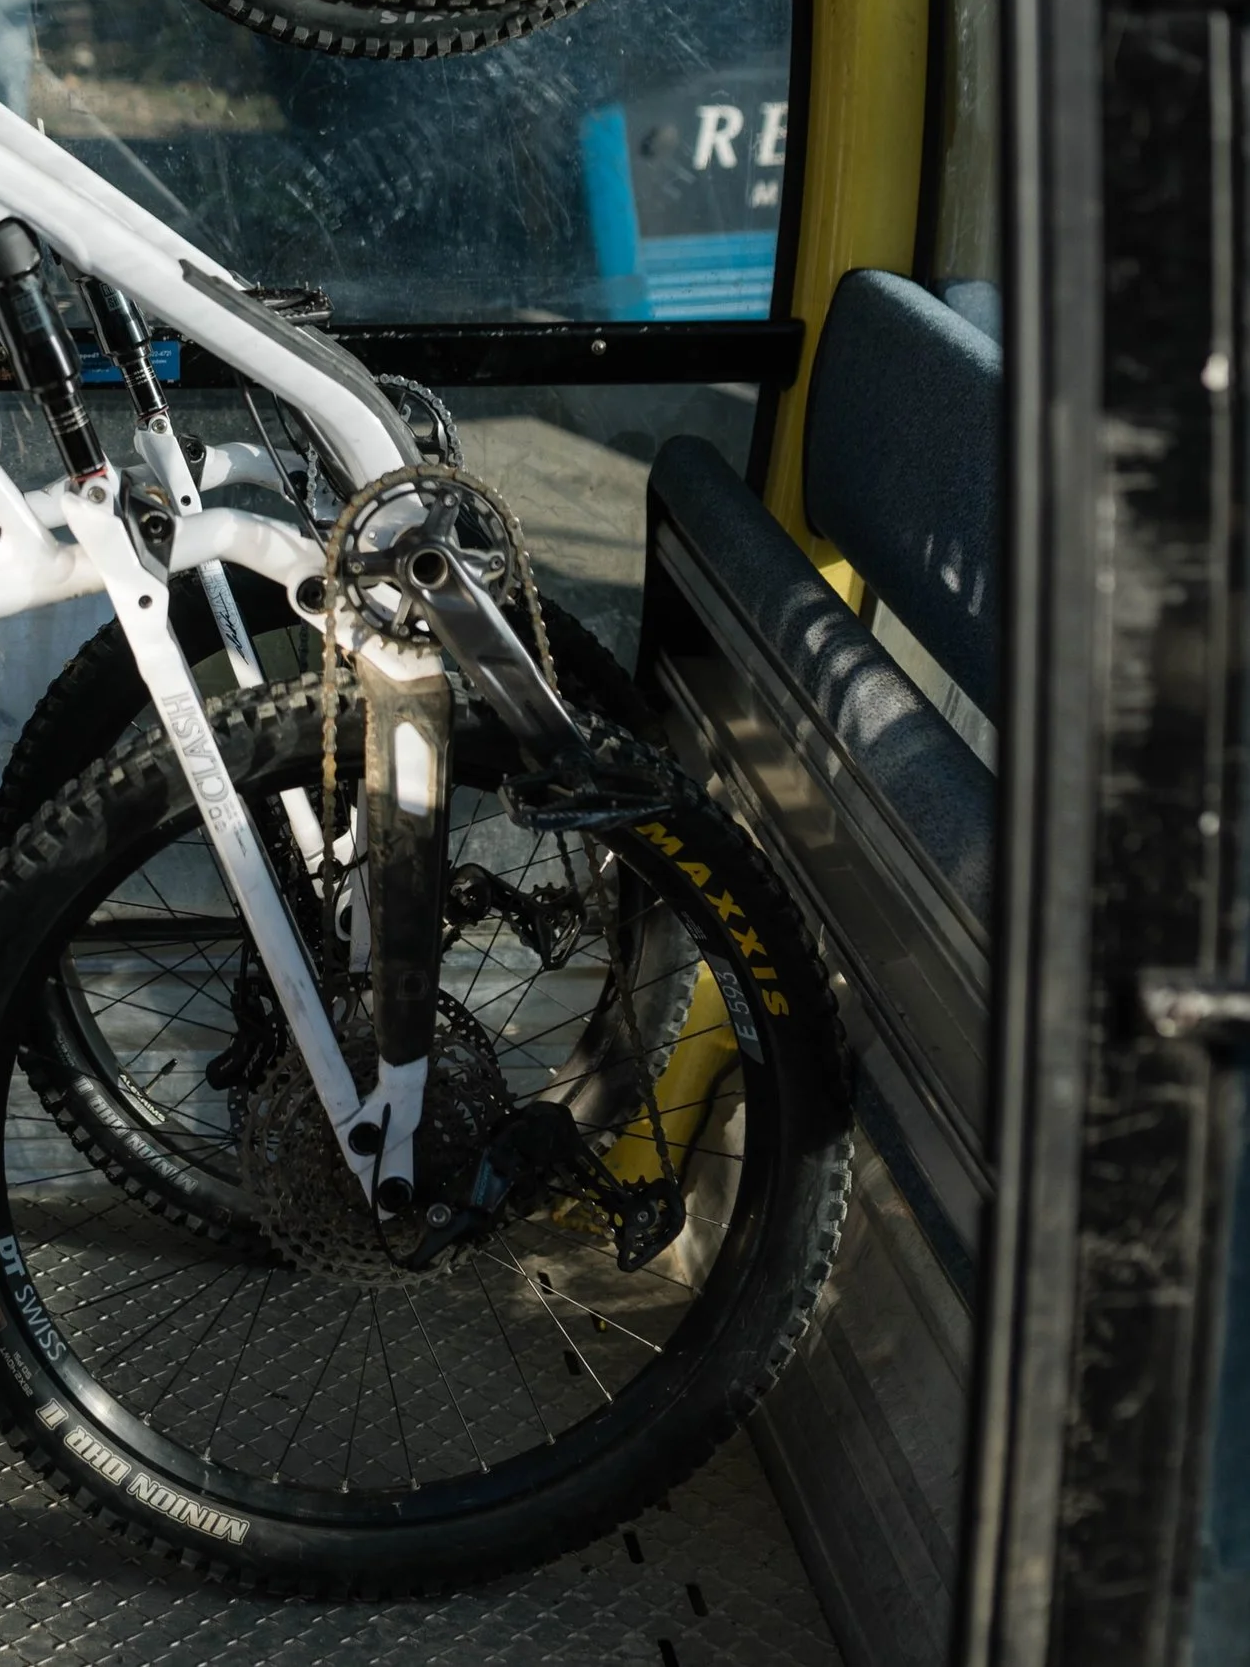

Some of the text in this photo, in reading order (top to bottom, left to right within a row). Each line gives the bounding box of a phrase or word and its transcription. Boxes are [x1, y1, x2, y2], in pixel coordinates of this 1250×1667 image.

[162, 690, 233, 804] CLASH
[636, 821, 790, 1018] MAXXIS
[722, 970, 752, 1016] 593
[13, 1285, 67, 1363] SWISS
[63, 1424, 132, 1487] DHR
[126, 1472, 251, 1546] MINION
